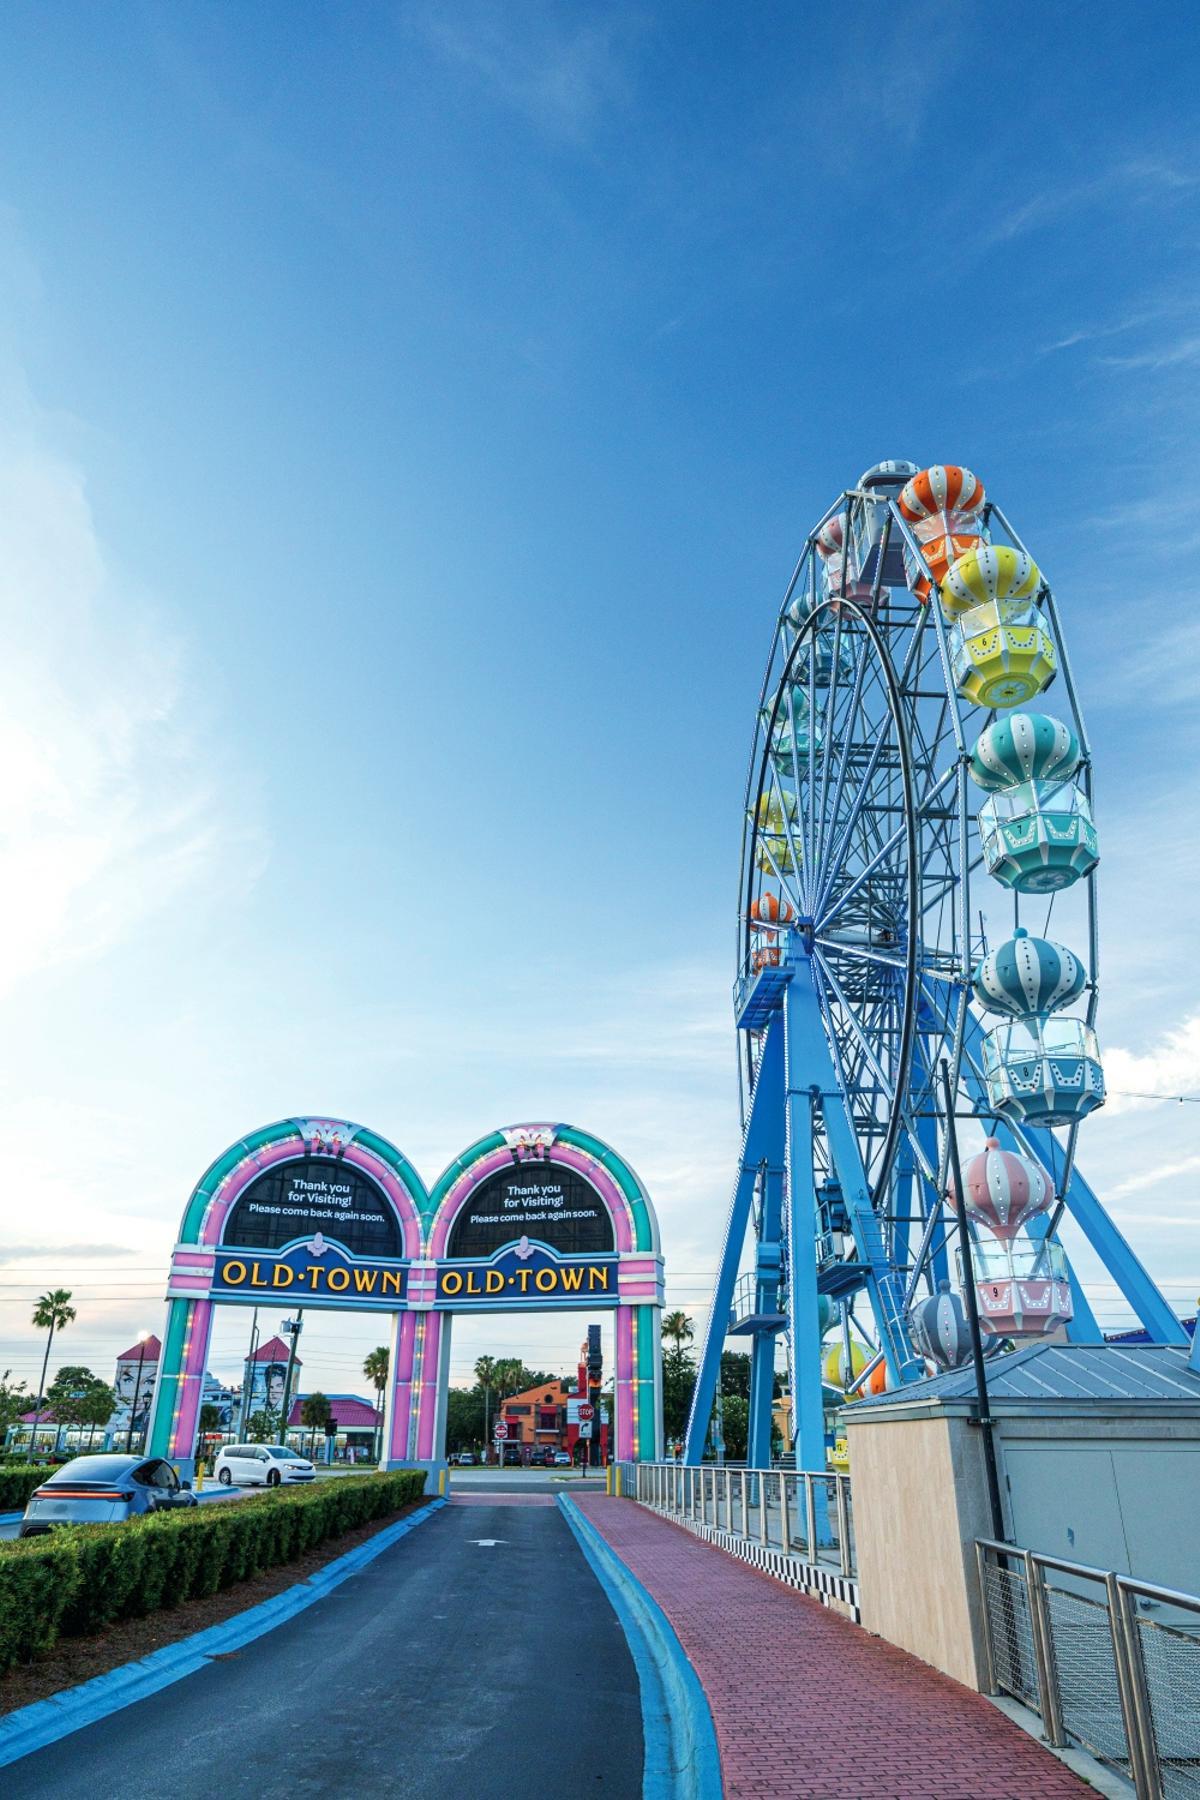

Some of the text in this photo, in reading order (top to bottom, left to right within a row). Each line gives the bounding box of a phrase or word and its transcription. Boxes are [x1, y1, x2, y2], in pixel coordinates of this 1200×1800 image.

[982, 637, 987, 646] 6
[1017, 825, 1022, 835] 7
[1023, 1066, 1029, 1077] 8
[293, 1179, 350, 1194] Thank you
[507, 1184, 561, 1196] Thank you
[288, 1191, 352, 1208] for Visiting!
[504, 1195, 564, 1208] for Visiting!
[249, 1203, 385, 1222] Please come back again soon.
[470, 1209, 598, 1224] Please come back again soon.
[993, 1286, 998, 1298] 9
[579, 1408, 593, 1416] STOP
